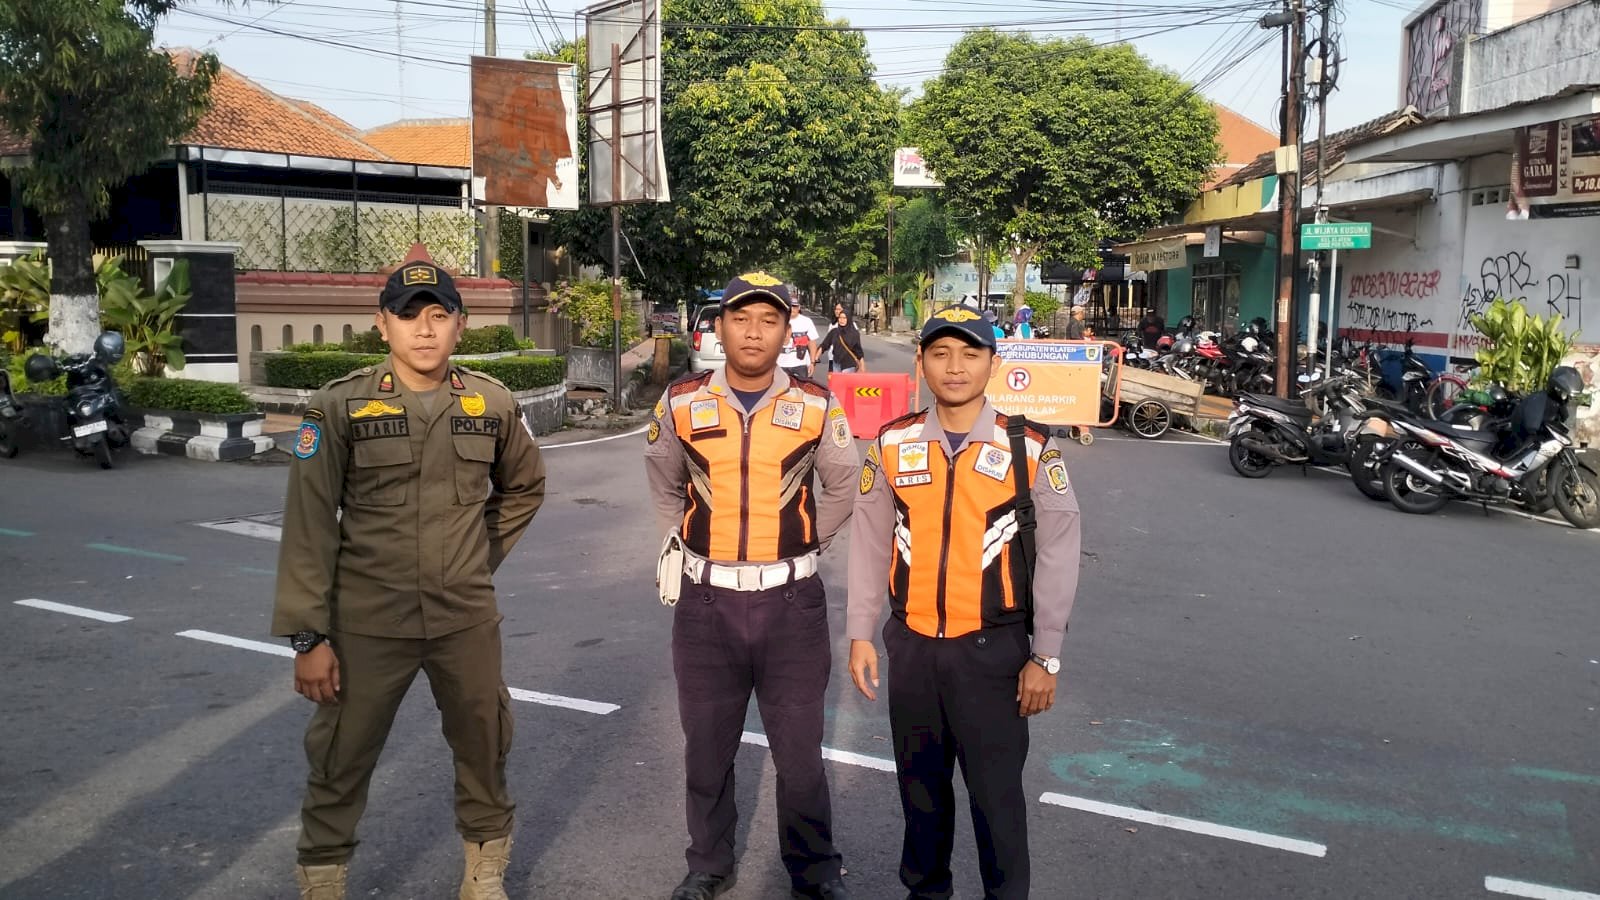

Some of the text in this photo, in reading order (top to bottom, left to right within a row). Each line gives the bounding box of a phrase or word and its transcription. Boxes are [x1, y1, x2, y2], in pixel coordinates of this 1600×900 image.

[1524, 164, 1552, 178] GARAM
[1314, 226, 1338, 235] WIJAYA
[1340, 226, 1369, 234] KUSUMA
[1009, 345, 1049, 353] KABUPATEN
[1001, 351, 1069, 360] PERHUBUNGAN
[1038, 395, 1077, 405] PARKIR
[1024, 406, 1056, 415] JALAN
[353, 420, 405, 438] SYARIF
[901, 442, 926, 454] DISHUB
[976, 464, 1003, 479] DISHUB
[898, 474, 929, 486] ARIS
